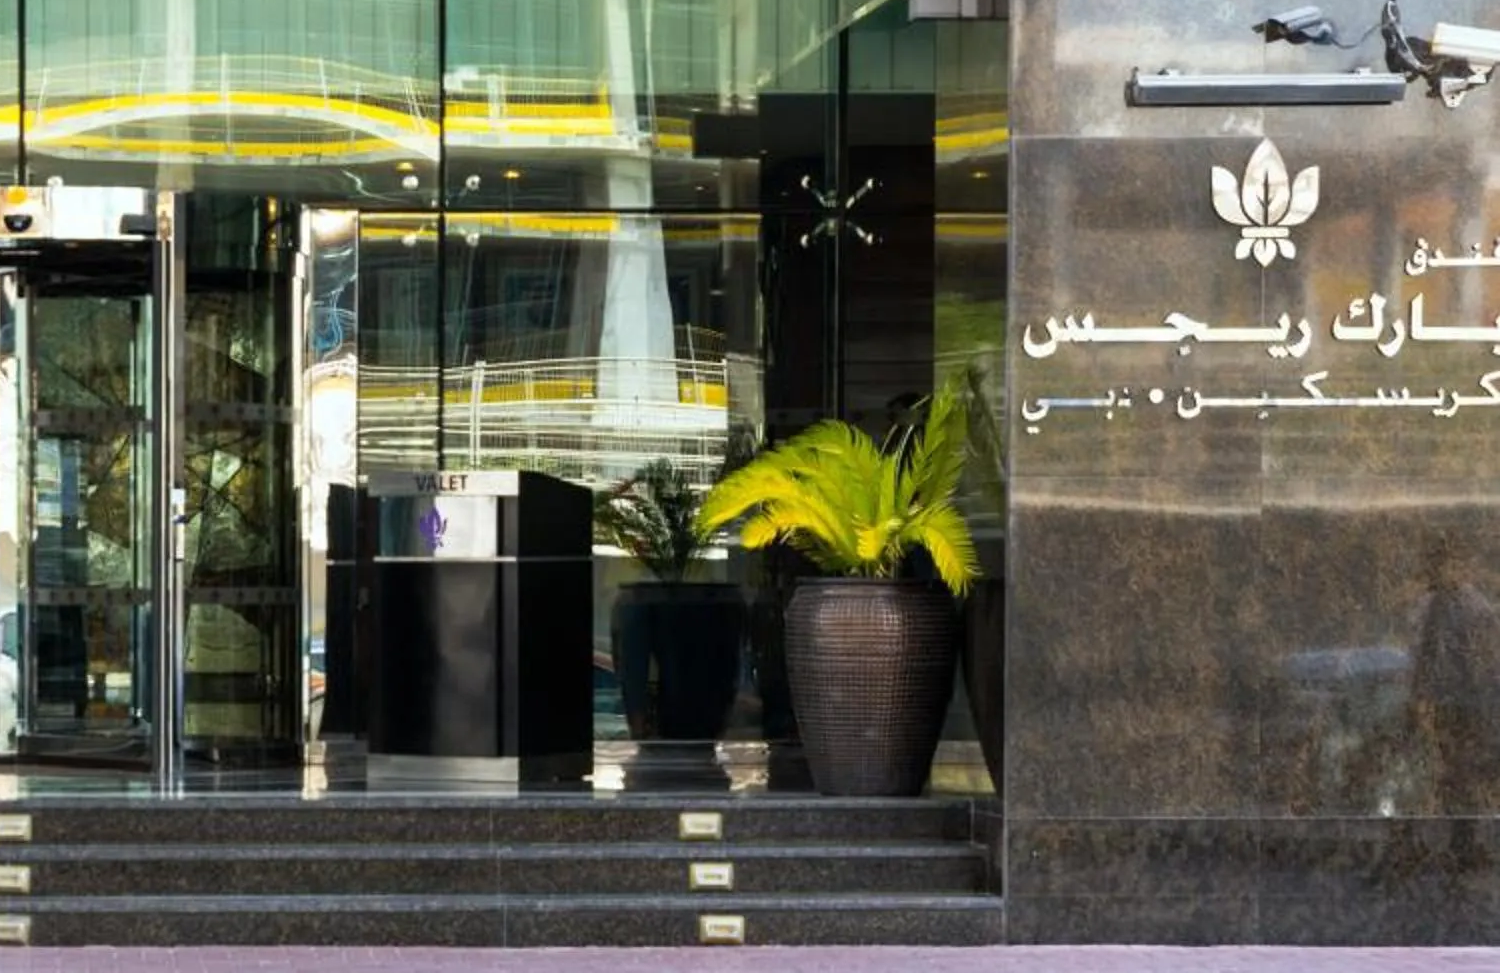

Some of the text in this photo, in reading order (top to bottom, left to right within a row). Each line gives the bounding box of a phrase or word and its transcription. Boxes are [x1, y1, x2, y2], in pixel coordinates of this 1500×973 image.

[1022, 310, 1312, 359] ريجس
[1021, 387, 1132, 435] دبي
[415, 474, 469, 492] VALET
